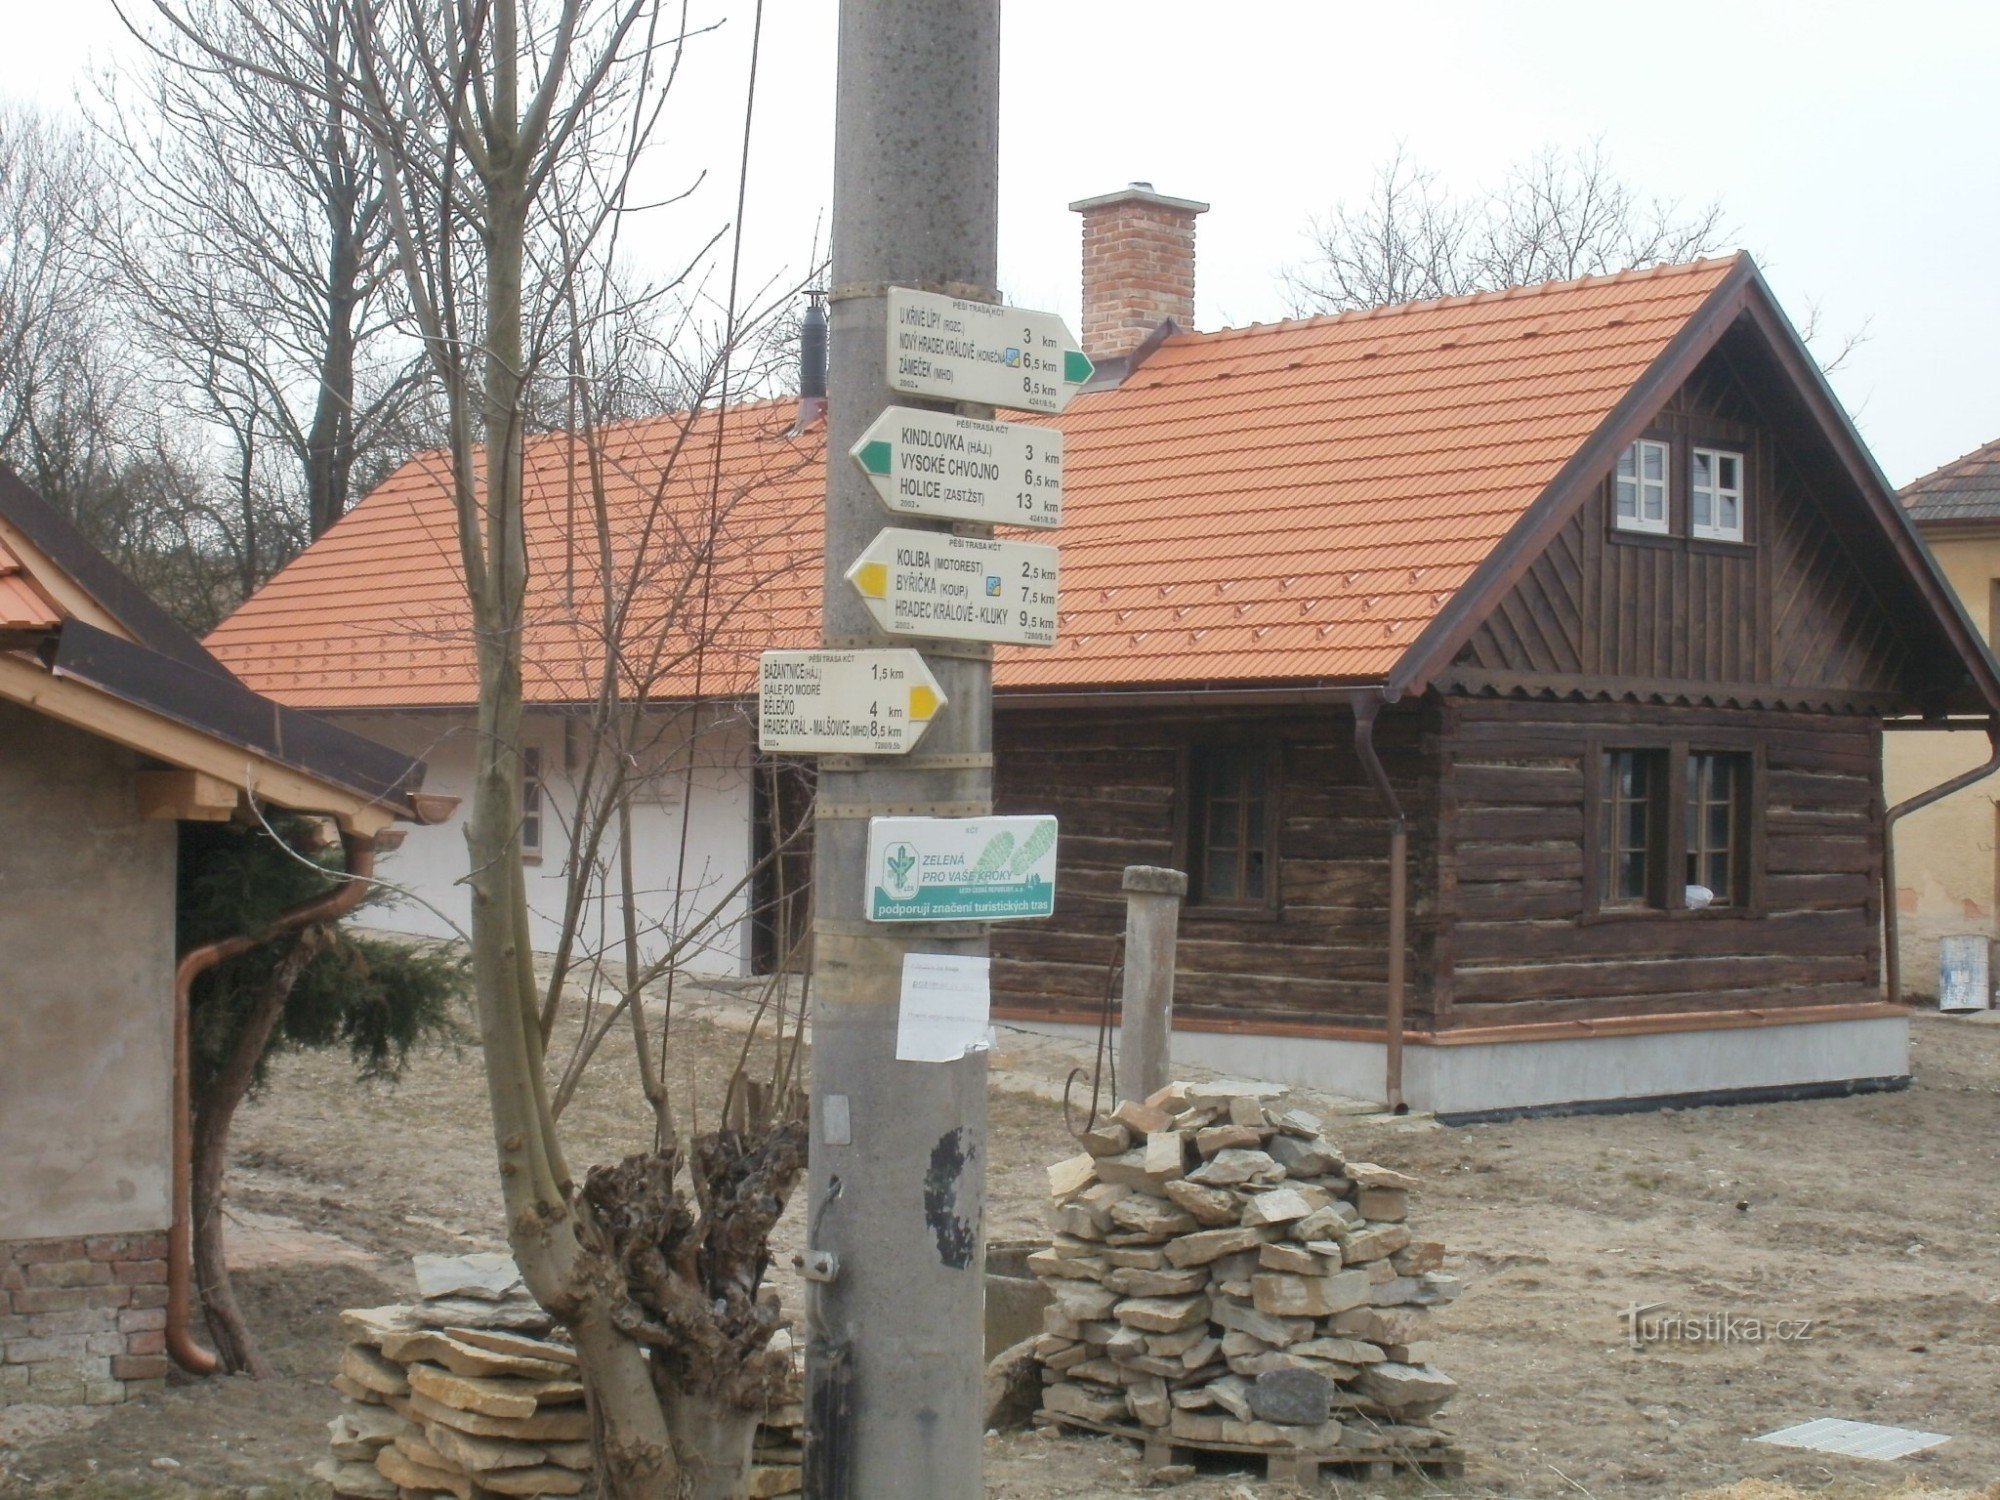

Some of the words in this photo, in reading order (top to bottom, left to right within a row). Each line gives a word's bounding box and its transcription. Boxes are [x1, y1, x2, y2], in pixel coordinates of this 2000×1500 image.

[900, 307, 905, 324] U
[927, 308, 942, 329] LÍPY
[1024, 328, 1032, 344] 3
[1042, 336, 1057, 348] km
[900, 331, 918, 351] NOVÝ
[918, 335, 944, 355] HRADEC
[946, 338, 975, 360] KRÁLOVÉ
[1023, 352, 1040, 370] 6,5
[1042, 360, 1057, 372] km
[899, 354, 932, 378] ZÁMEČEK
[934, 368, 954, 384] (MHD)
[1023, 376, 1040, 394] 8,5
[1042, 384, 1057, 396] km
[973, 422, 994, 432] TRASA
[996, 424, 1009, 434] KČT
[902, 427, 964, 452] KINDLOVKA
[968, 440, 992, 458] (HÁJ.)
[1025, 444, 1033, 460] 3
[1045, 452, 1060, 464] km
[900, 452, 945, 474] VYSOKÉ
[948, 459, 1000, 480] CHVOJNO
[1024, 469, 1042, 487] 6,5
[1044, 476, 1059, 488] km
[900, 478, 941, 498] HOLICE
[1016, 492, 1032, 510] 13
[1044, 500, 1058, 512] km
[965, 540, 987, 551] TRASA
[988, 541, 1002, 552] KČT
[897, 548, 930, 568] KOLIBA
[934, 558, 984, 576] (MOTOREST)
[1022, 562, 1039, 580] 2,5
[1041, 568, 1056, 580] km
[896, 572, 936, 594] BYŘIČKA
[940, 583, 968, 600] (KOUP.)
[1022, 586, 1038, 604] 7,5
[1040, 592, 1055, 604] km
[895, 599, 932, 618] HRADEC
[933, 600, 974, 622] KRÁLOVÉ
[980, 607, 1008, 624] KLUKY
[1020, 610, 1037, 629] 9,5
[1040, 617, 1054, 629] km
[764, 659, 804, 680] BAŽANTNICE
[872, 664, 888, 680] 1,5
[890, 665, 904, 680] km
[843, 654, 855, 662] KČT
[784, 684, 794, 696] PO
[764, 696, 794, 715] BĚLEČKO
[870, 700, 878, 718] 4
[888, 704, 903, 718] km
[764, 718, 789, 736] HRADEC
[814, 716, 850, 736] MALŠOVICE
[850, 725, 870, 739] (MHD)
[870, 720, 886, 738] 8,5
[888, 726, 902, 738] km
[922, 852, 965, 866] ZELENÁ
[922, 872, 946, 882] PRO
[948, 870, 976, 882] VAŠE
[977, 870, 1014, 881] KROKY
[878, 902, 930, 916] podporují
[932, 902, 972, 914] značení
[974, 899, 1029, 912] turistických
[1031, 900, 1048, 910] tras
